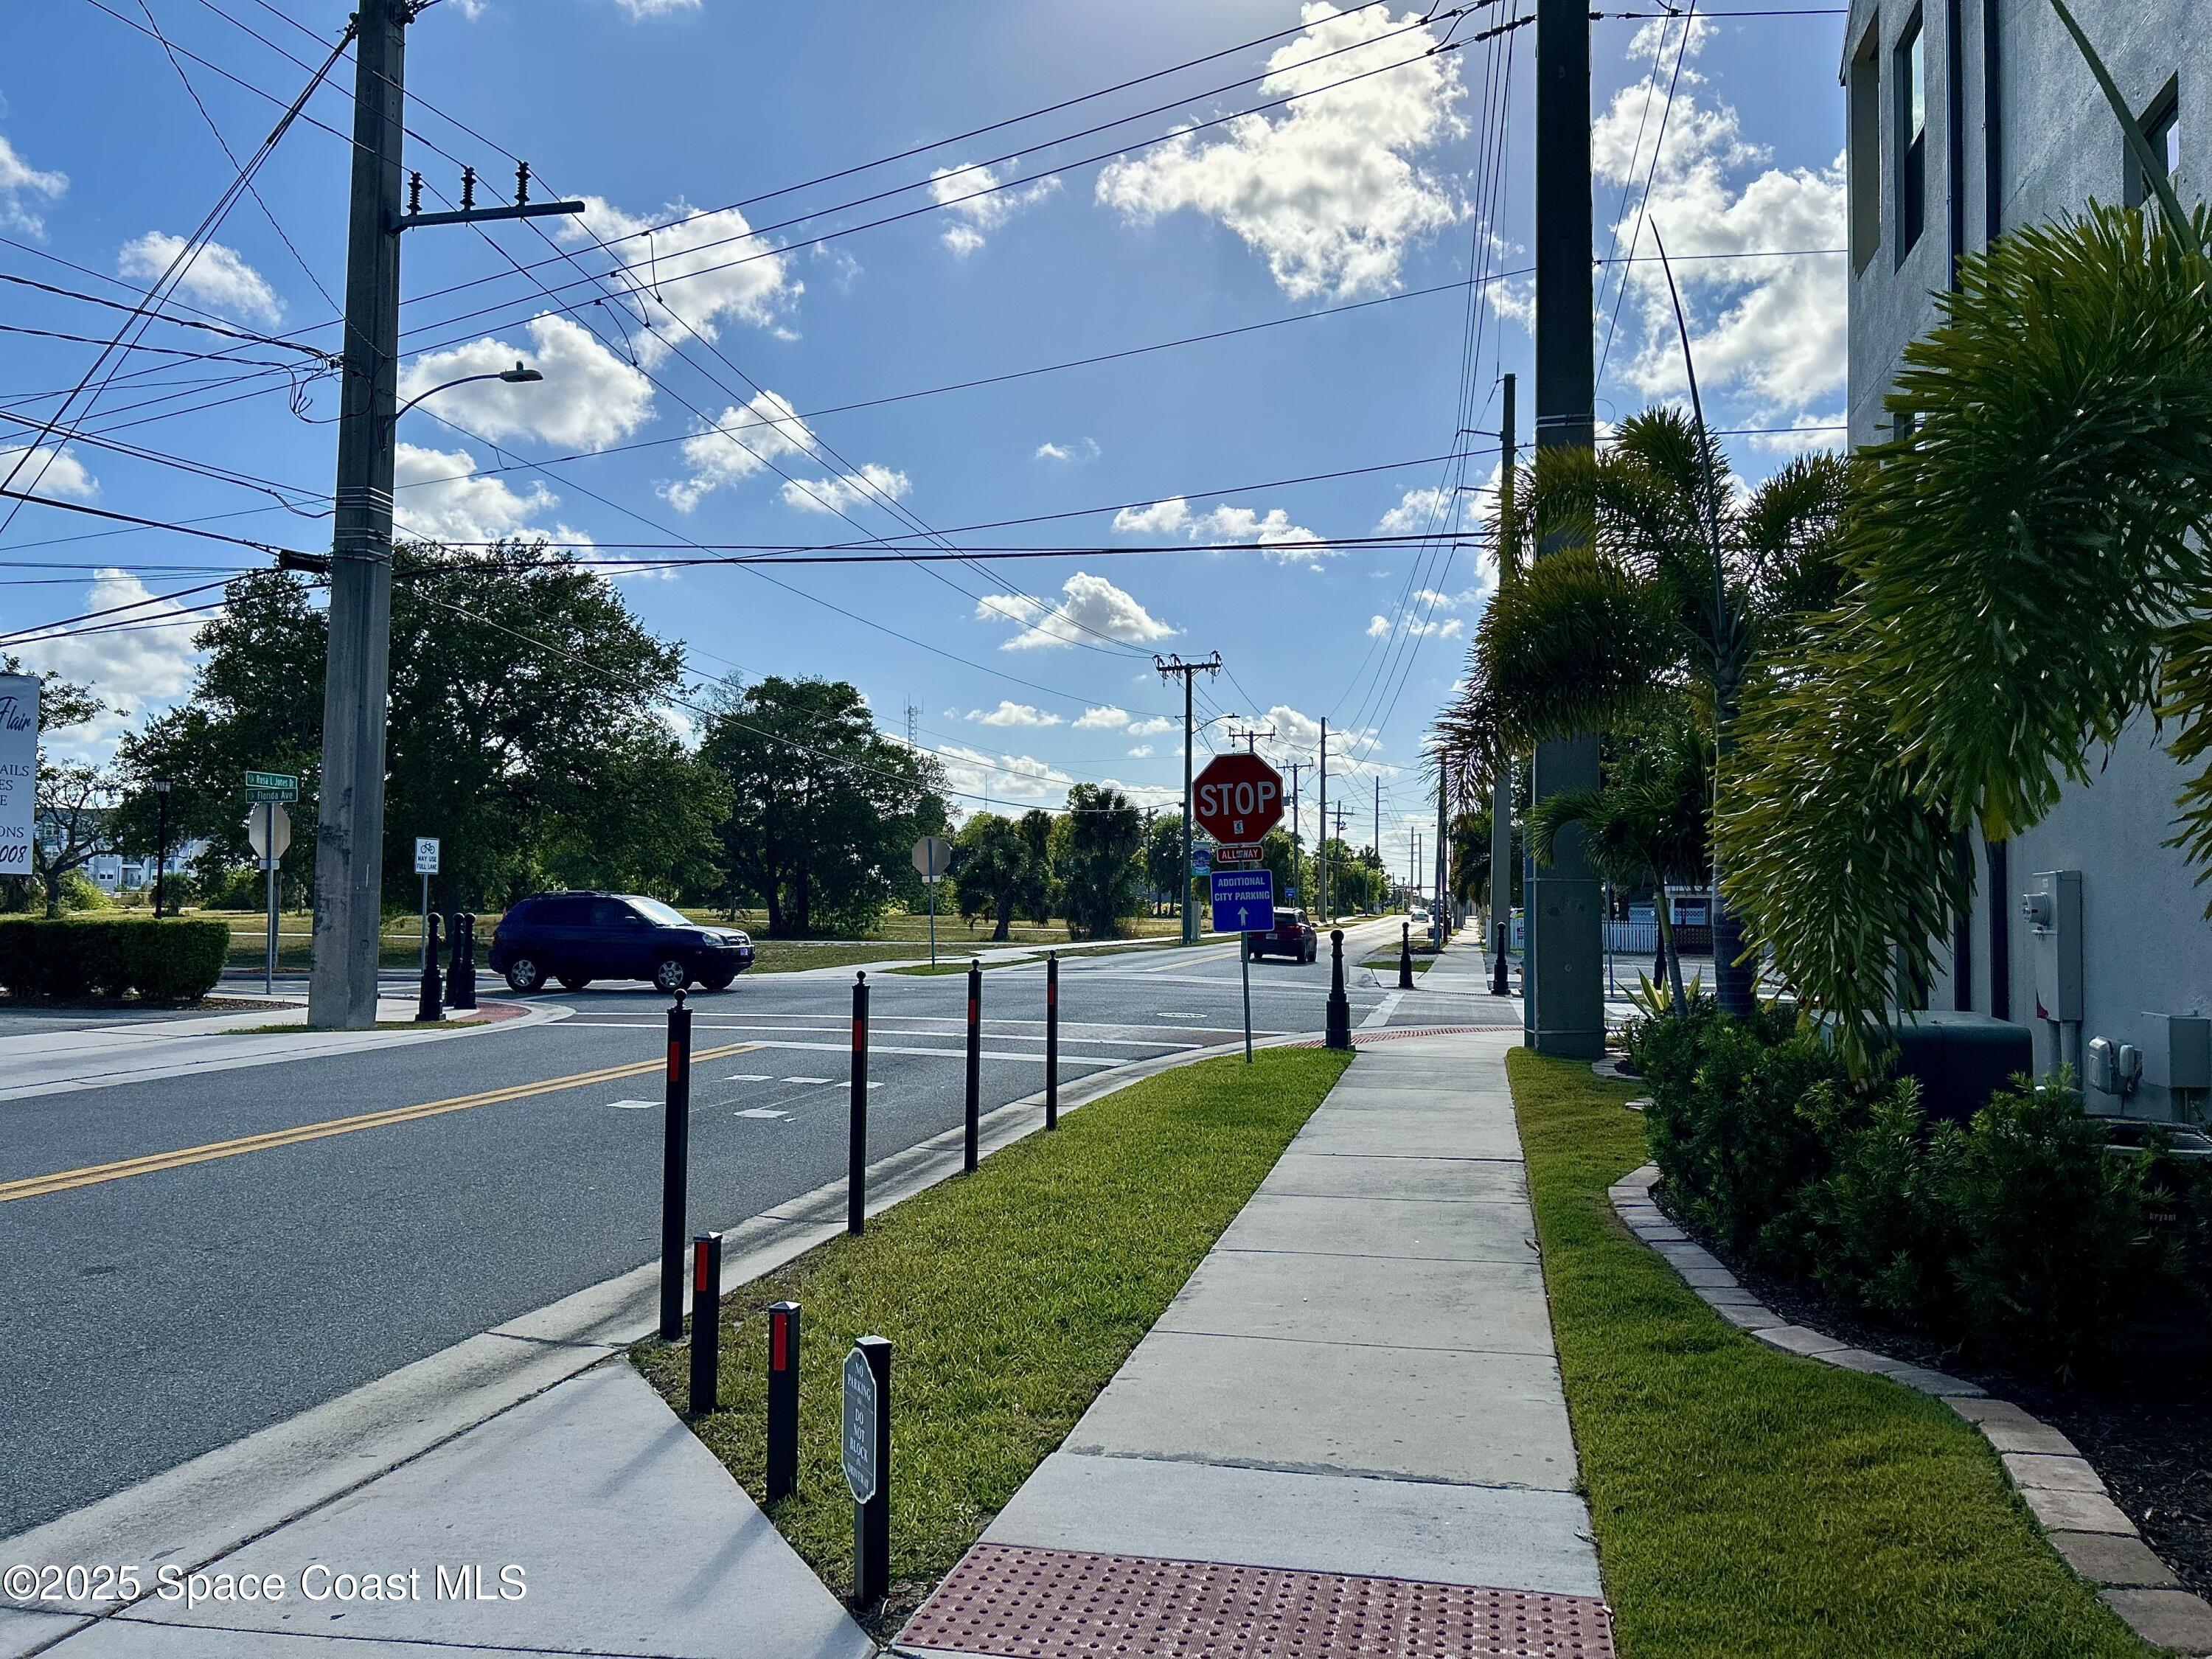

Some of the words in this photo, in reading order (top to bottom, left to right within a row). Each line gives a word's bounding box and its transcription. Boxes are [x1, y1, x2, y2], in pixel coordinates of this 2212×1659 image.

[0, 696, 31, 731] Flair
[256, 775, 268, 785] Rosa
[270, 776, 273, 785] L
[274, 777, 288, 787] Jones
[289, 779, 294, 787] Dr
[257, 790, 279, 800] Florida
[281, 790, 293, 799] Ave
[1200, 782, 1276, 816] STOP
[1222, 850, 1237, 859] ALL
[1242, 849, 1259, 858] WAY
[1217, 877, 1265, 887] ADDITIONAL
[1214, 893, 1232, 901] CITY
[1235, 891, 1270, 900] PARKING
[855, 1362, 863, 1377] NO
[847, 1373, 871, 1401] PARKING
[855, 1408, 863, 1425] DO
[853, 1423, 865, 1442] NOT
[849, 1436, 868, 1463] BLOCK
[847, 1461, 869, 1489] DRIVEWAY
